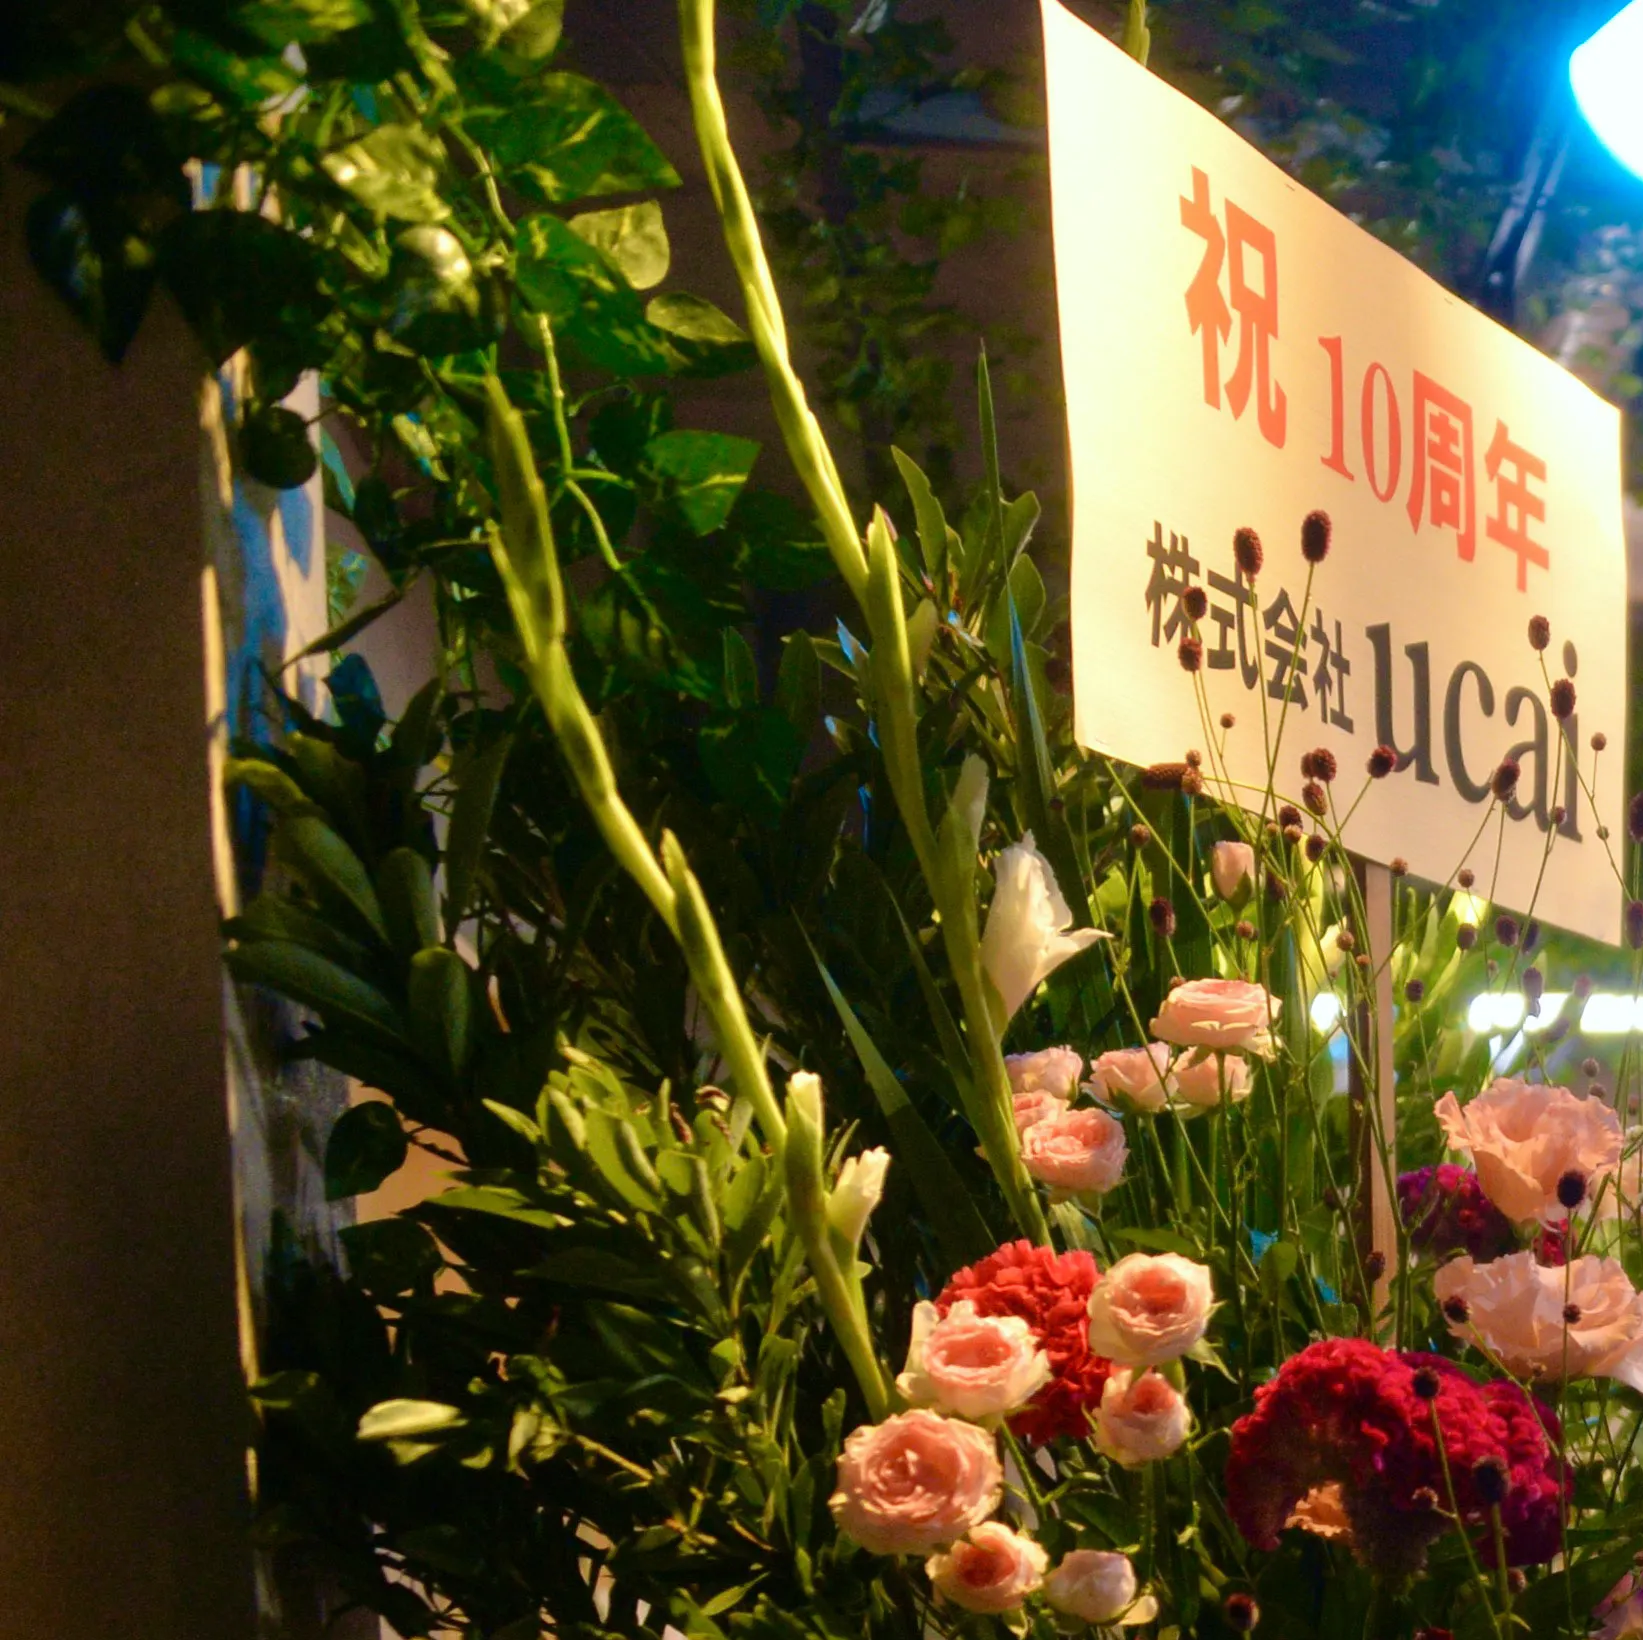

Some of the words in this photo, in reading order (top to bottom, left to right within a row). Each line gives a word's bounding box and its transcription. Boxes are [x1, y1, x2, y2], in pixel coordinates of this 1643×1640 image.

[1178, 163, 1288, 450] 祝
[1317, 335, 1551, 594] 10周年
[1144, 519, 1355, 735] 株式会社
[1364, 621, 1584, 844] ucai
